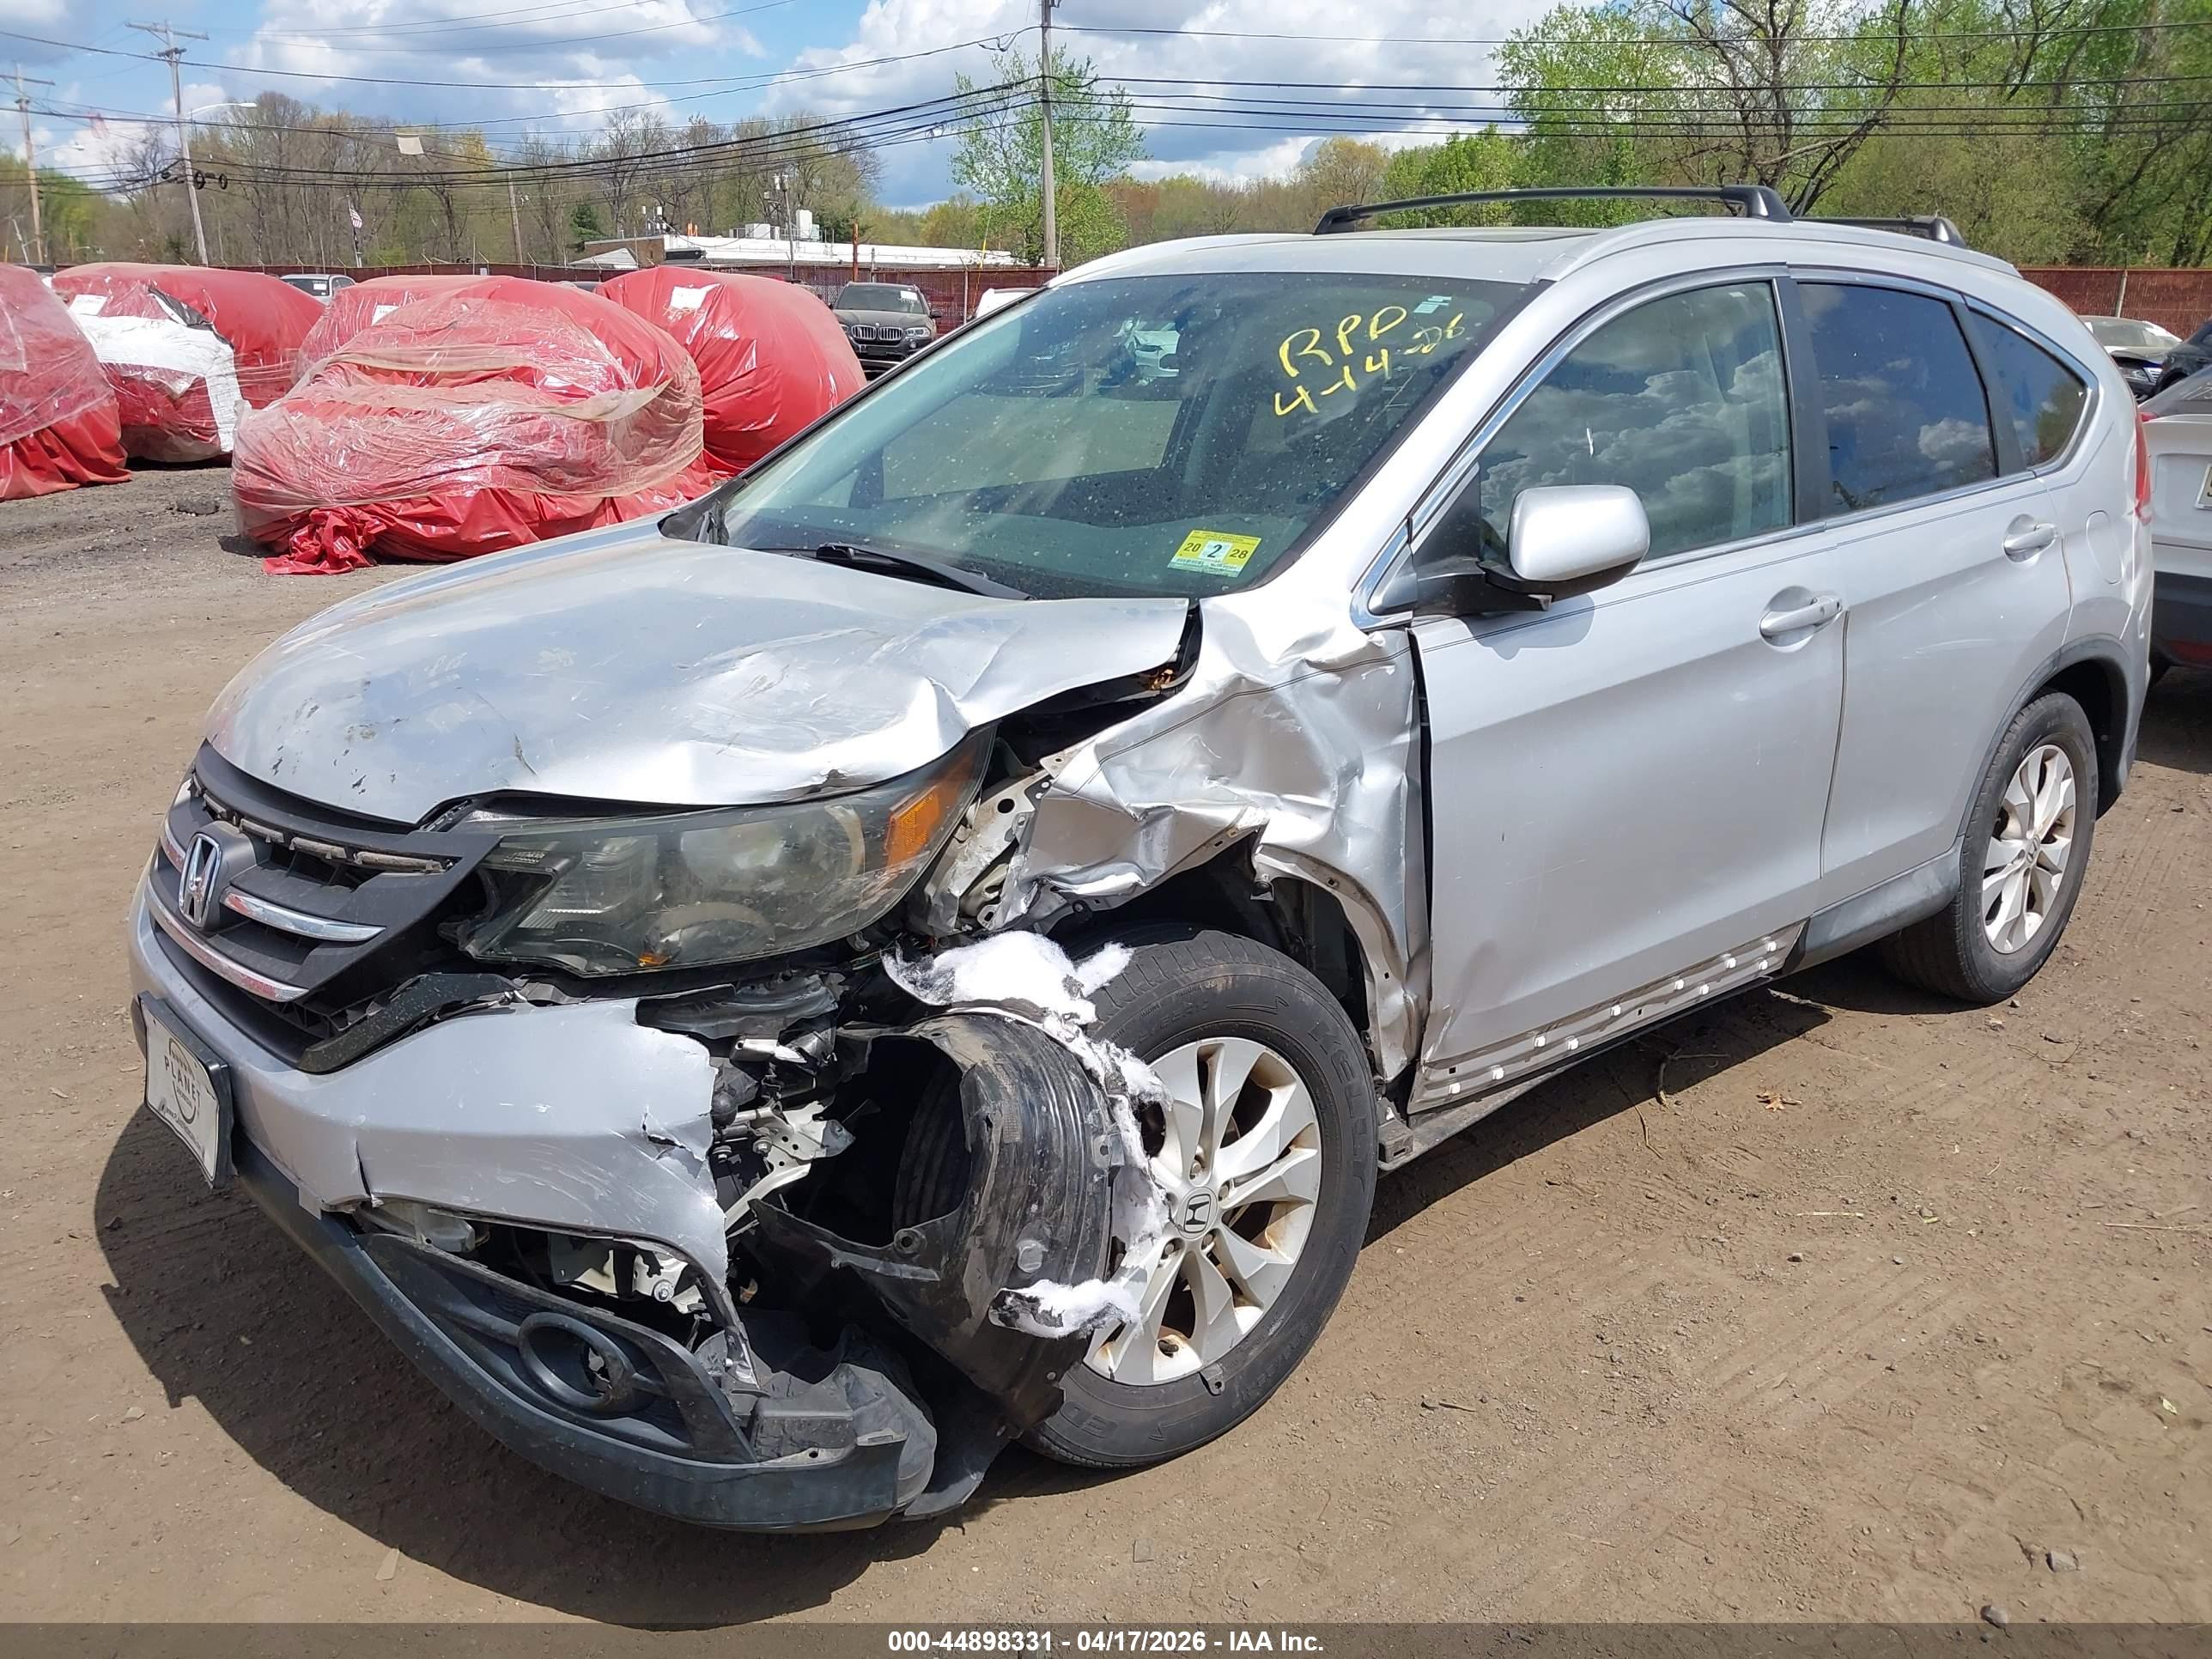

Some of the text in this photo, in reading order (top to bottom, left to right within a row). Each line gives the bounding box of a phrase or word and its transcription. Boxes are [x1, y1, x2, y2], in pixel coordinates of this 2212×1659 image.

[1183, 542, 1249, 559] 20 2 28
[164, 1054, 200, 1108] PLANET
